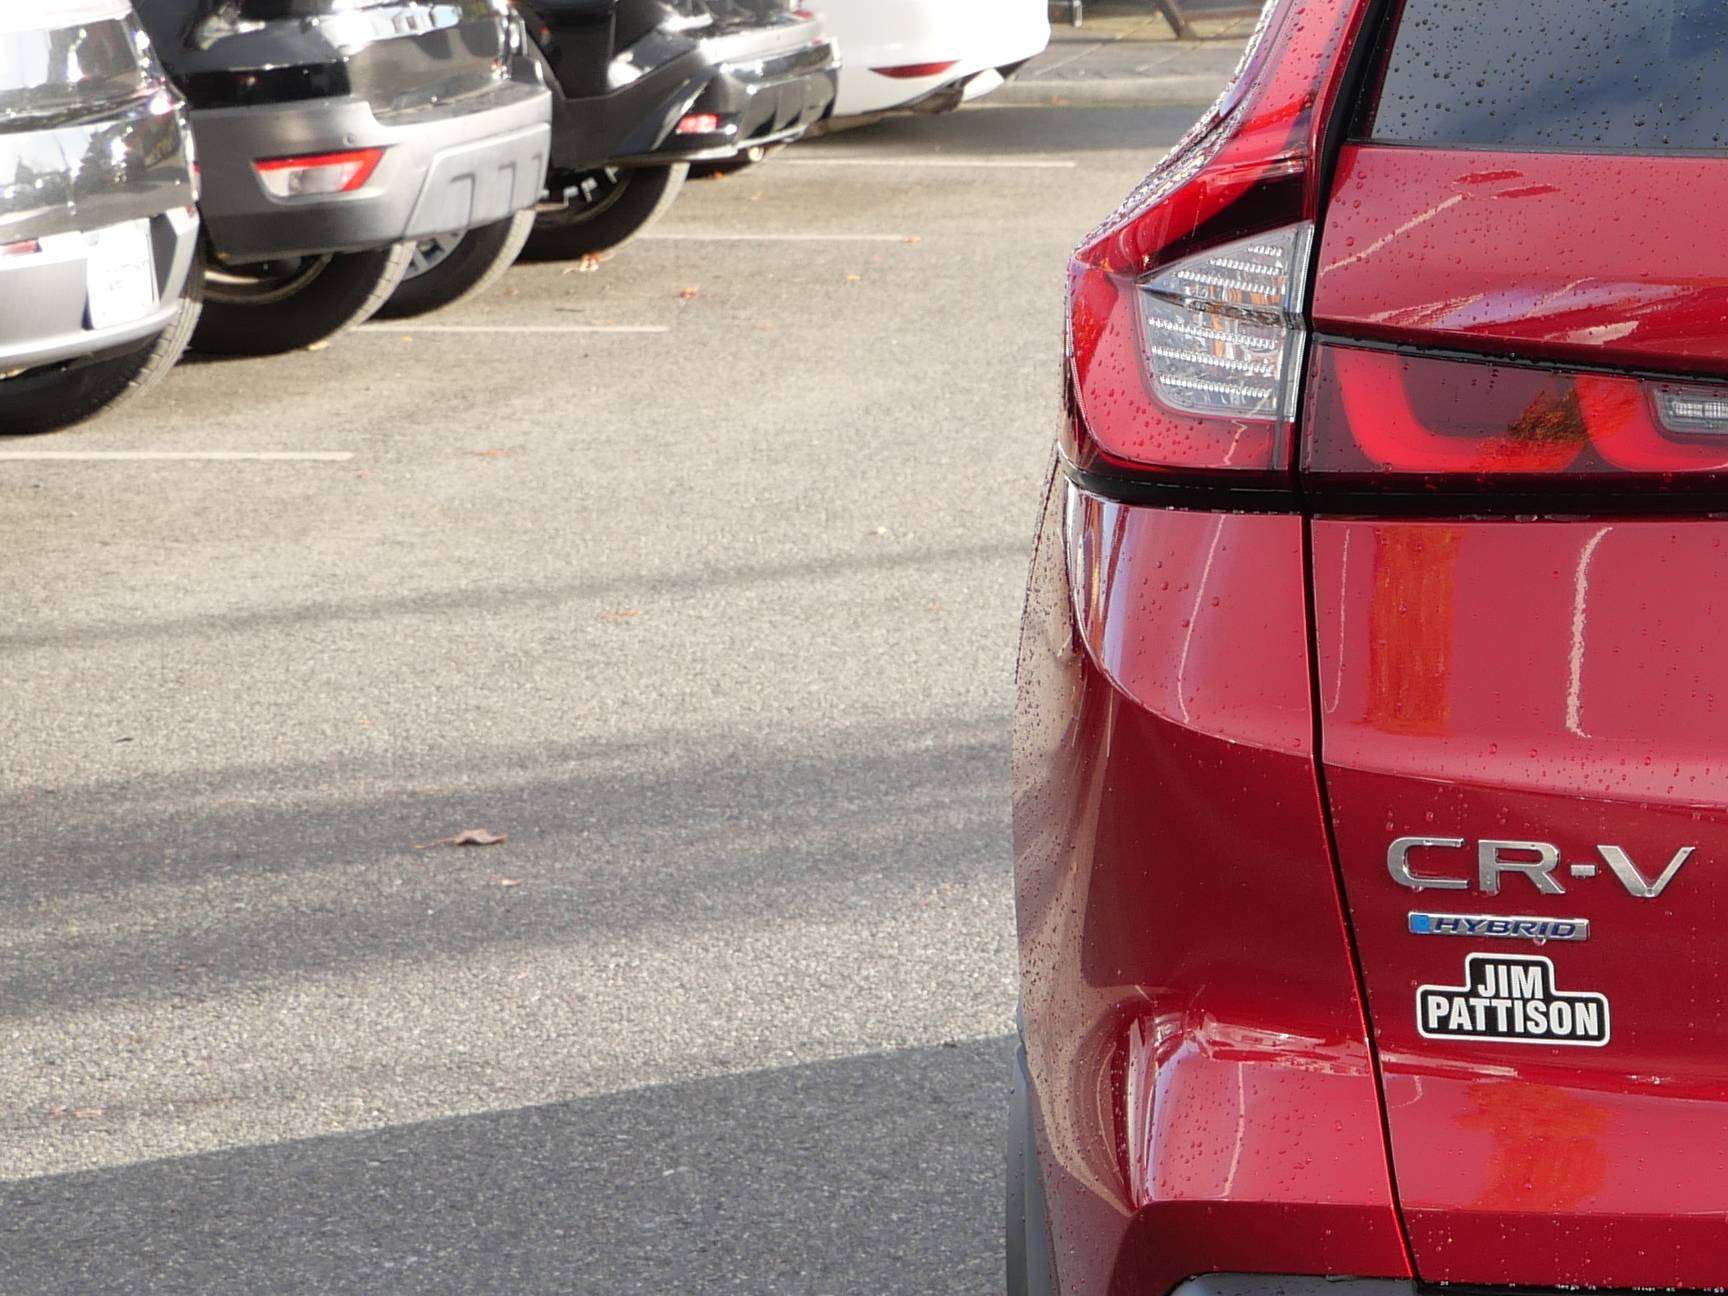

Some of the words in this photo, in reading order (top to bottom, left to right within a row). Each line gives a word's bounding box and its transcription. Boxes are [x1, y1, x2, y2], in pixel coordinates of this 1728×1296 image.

[1387, 836, 1697, 897] CR-V
[1434, 918, 1577, 938] HYBRID
[1477, 963, 1544, 1000] JIM
[1427, 995, 1599, 1037] PATTISON
